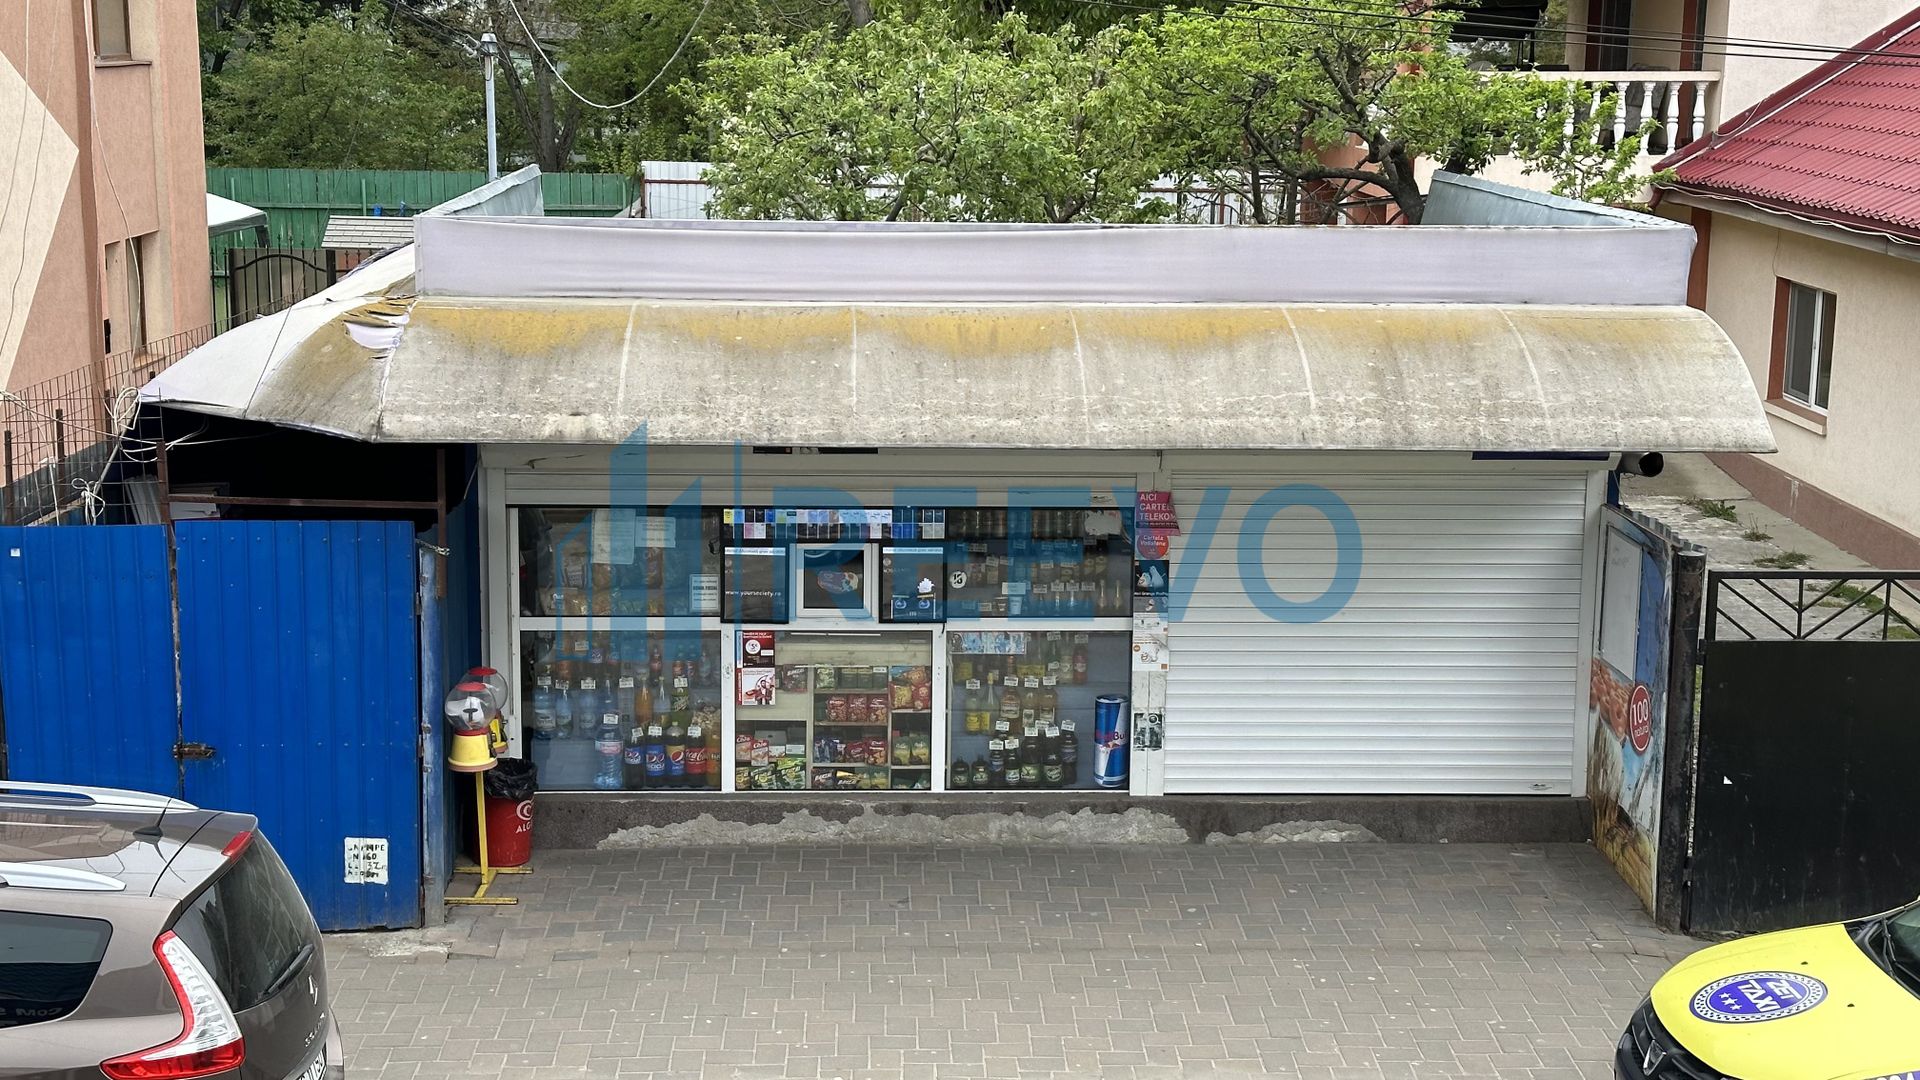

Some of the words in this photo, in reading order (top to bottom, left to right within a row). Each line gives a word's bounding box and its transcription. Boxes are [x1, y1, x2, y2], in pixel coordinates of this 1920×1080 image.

[1140, 493, 1157, 501] AICI
[1632, 698, 1649, 726] 100
[1737, 978, 1781, 1012] TAXI
[1766, 978, 1803, 1000] ZET
